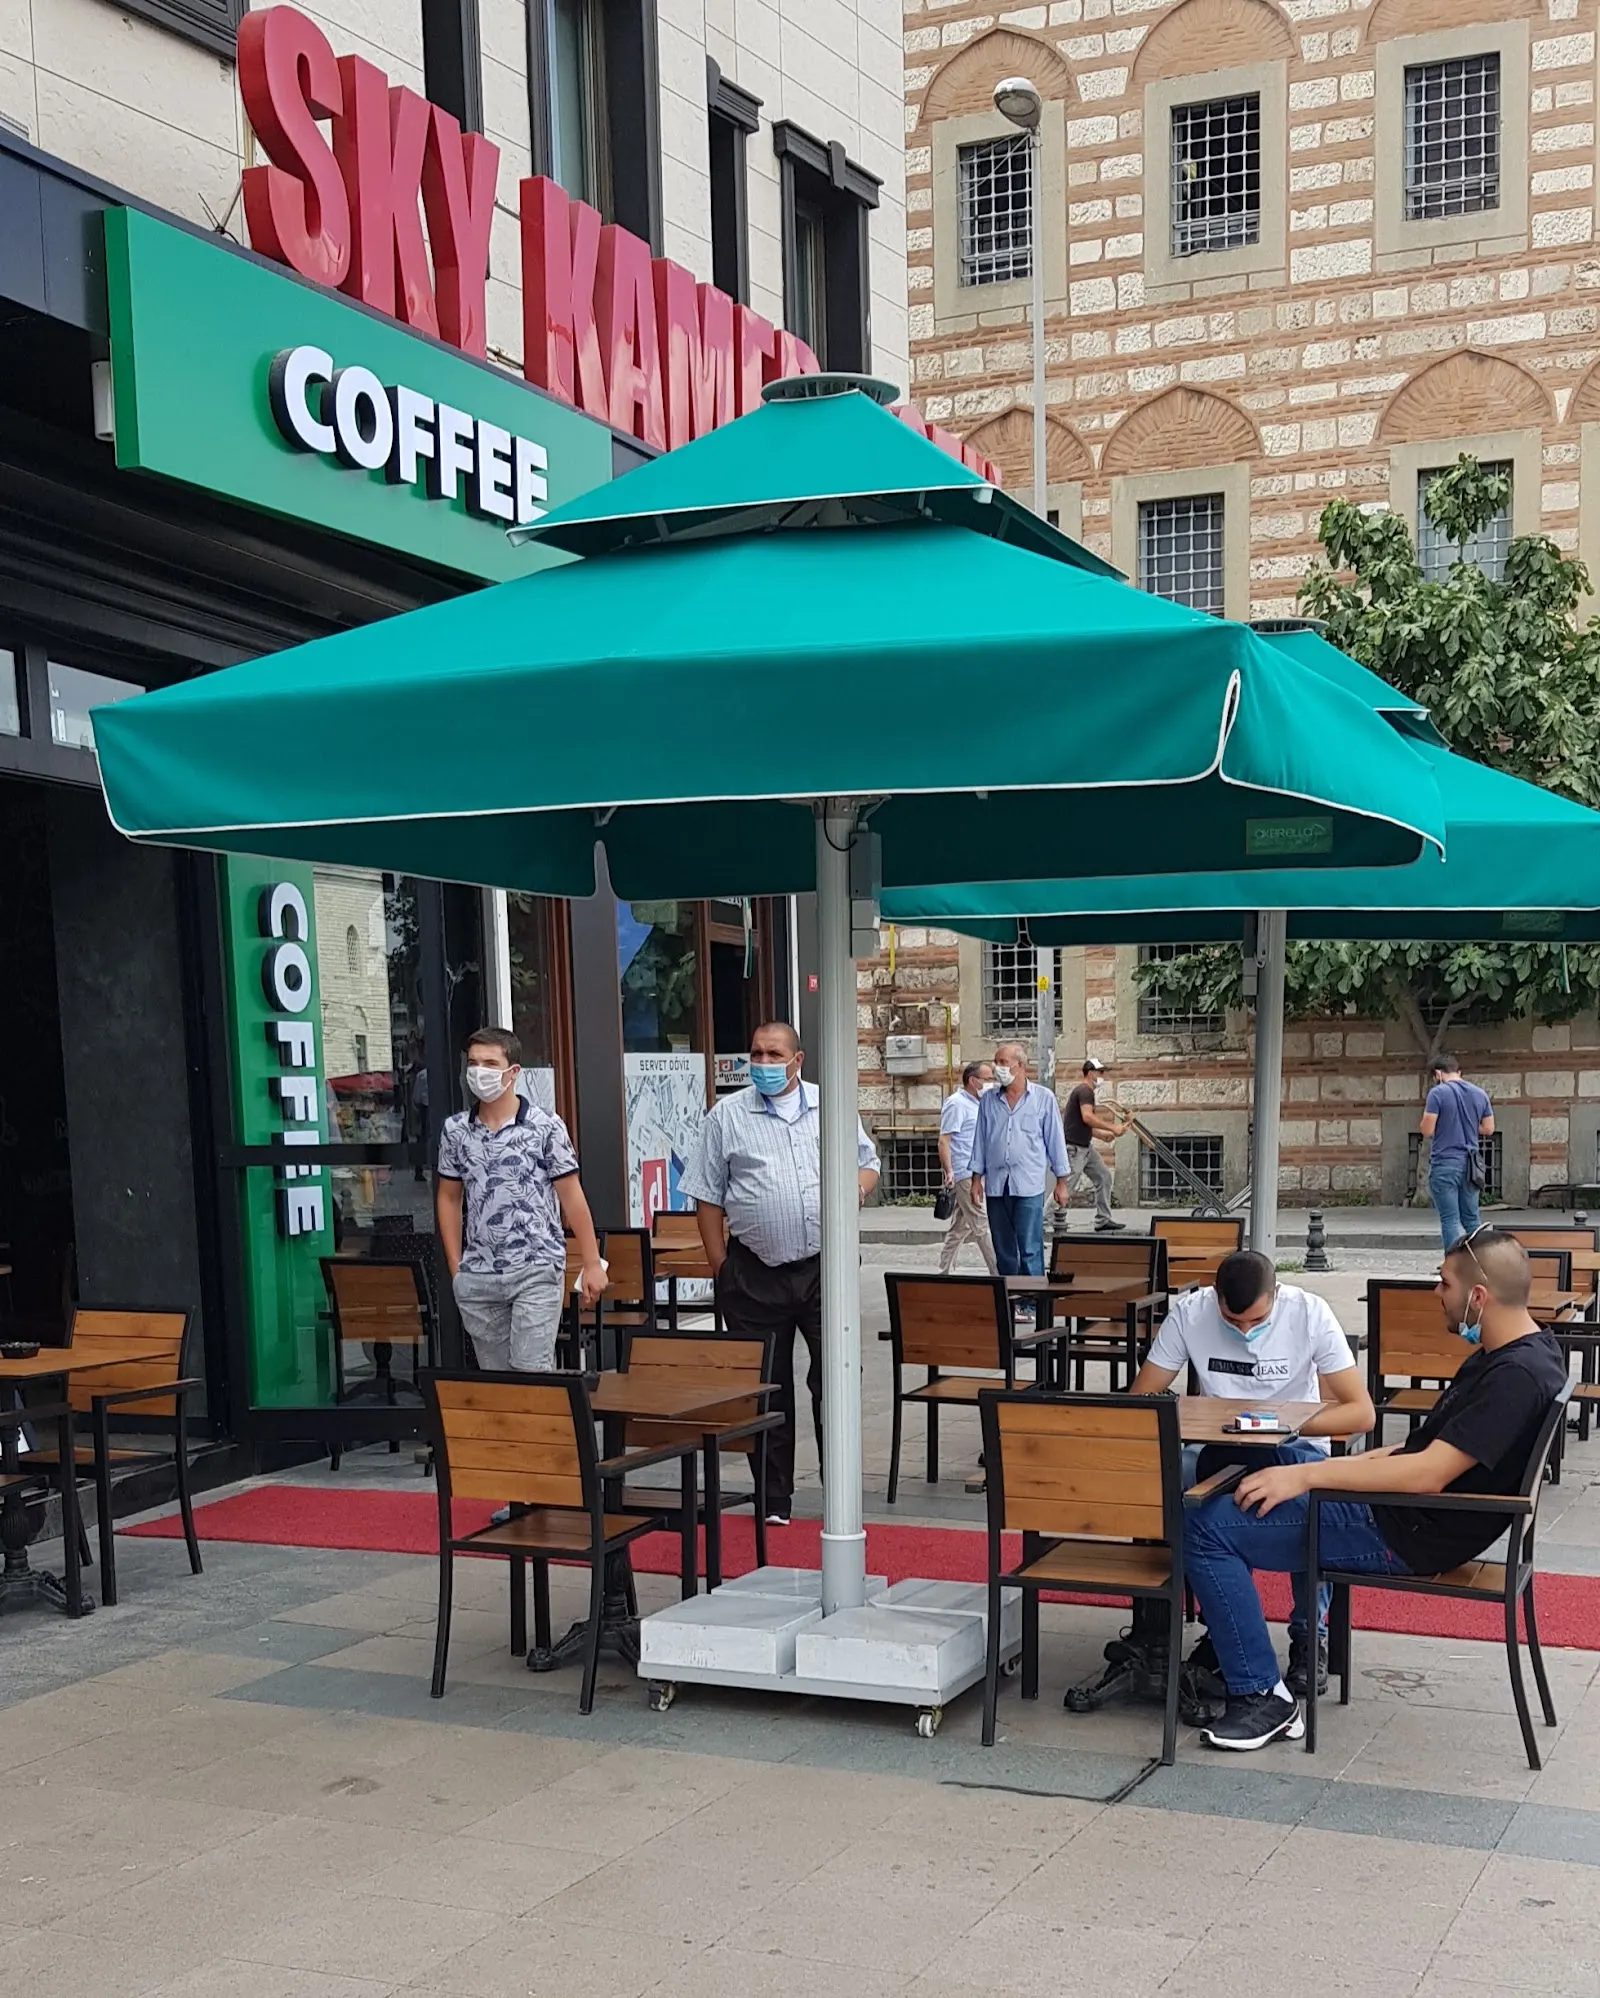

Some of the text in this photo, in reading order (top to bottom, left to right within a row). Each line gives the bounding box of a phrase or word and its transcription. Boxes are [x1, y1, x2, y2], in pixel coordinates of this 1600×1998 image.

[238, 5, 500, 361] SKY
[272, 345, 549, 525] COFFEE
[262, 882, 324, 1236] COFFEE
[640, 1060, 667, 1071] SERVET
[1257, 1364, 1288, 1376] JEANS
